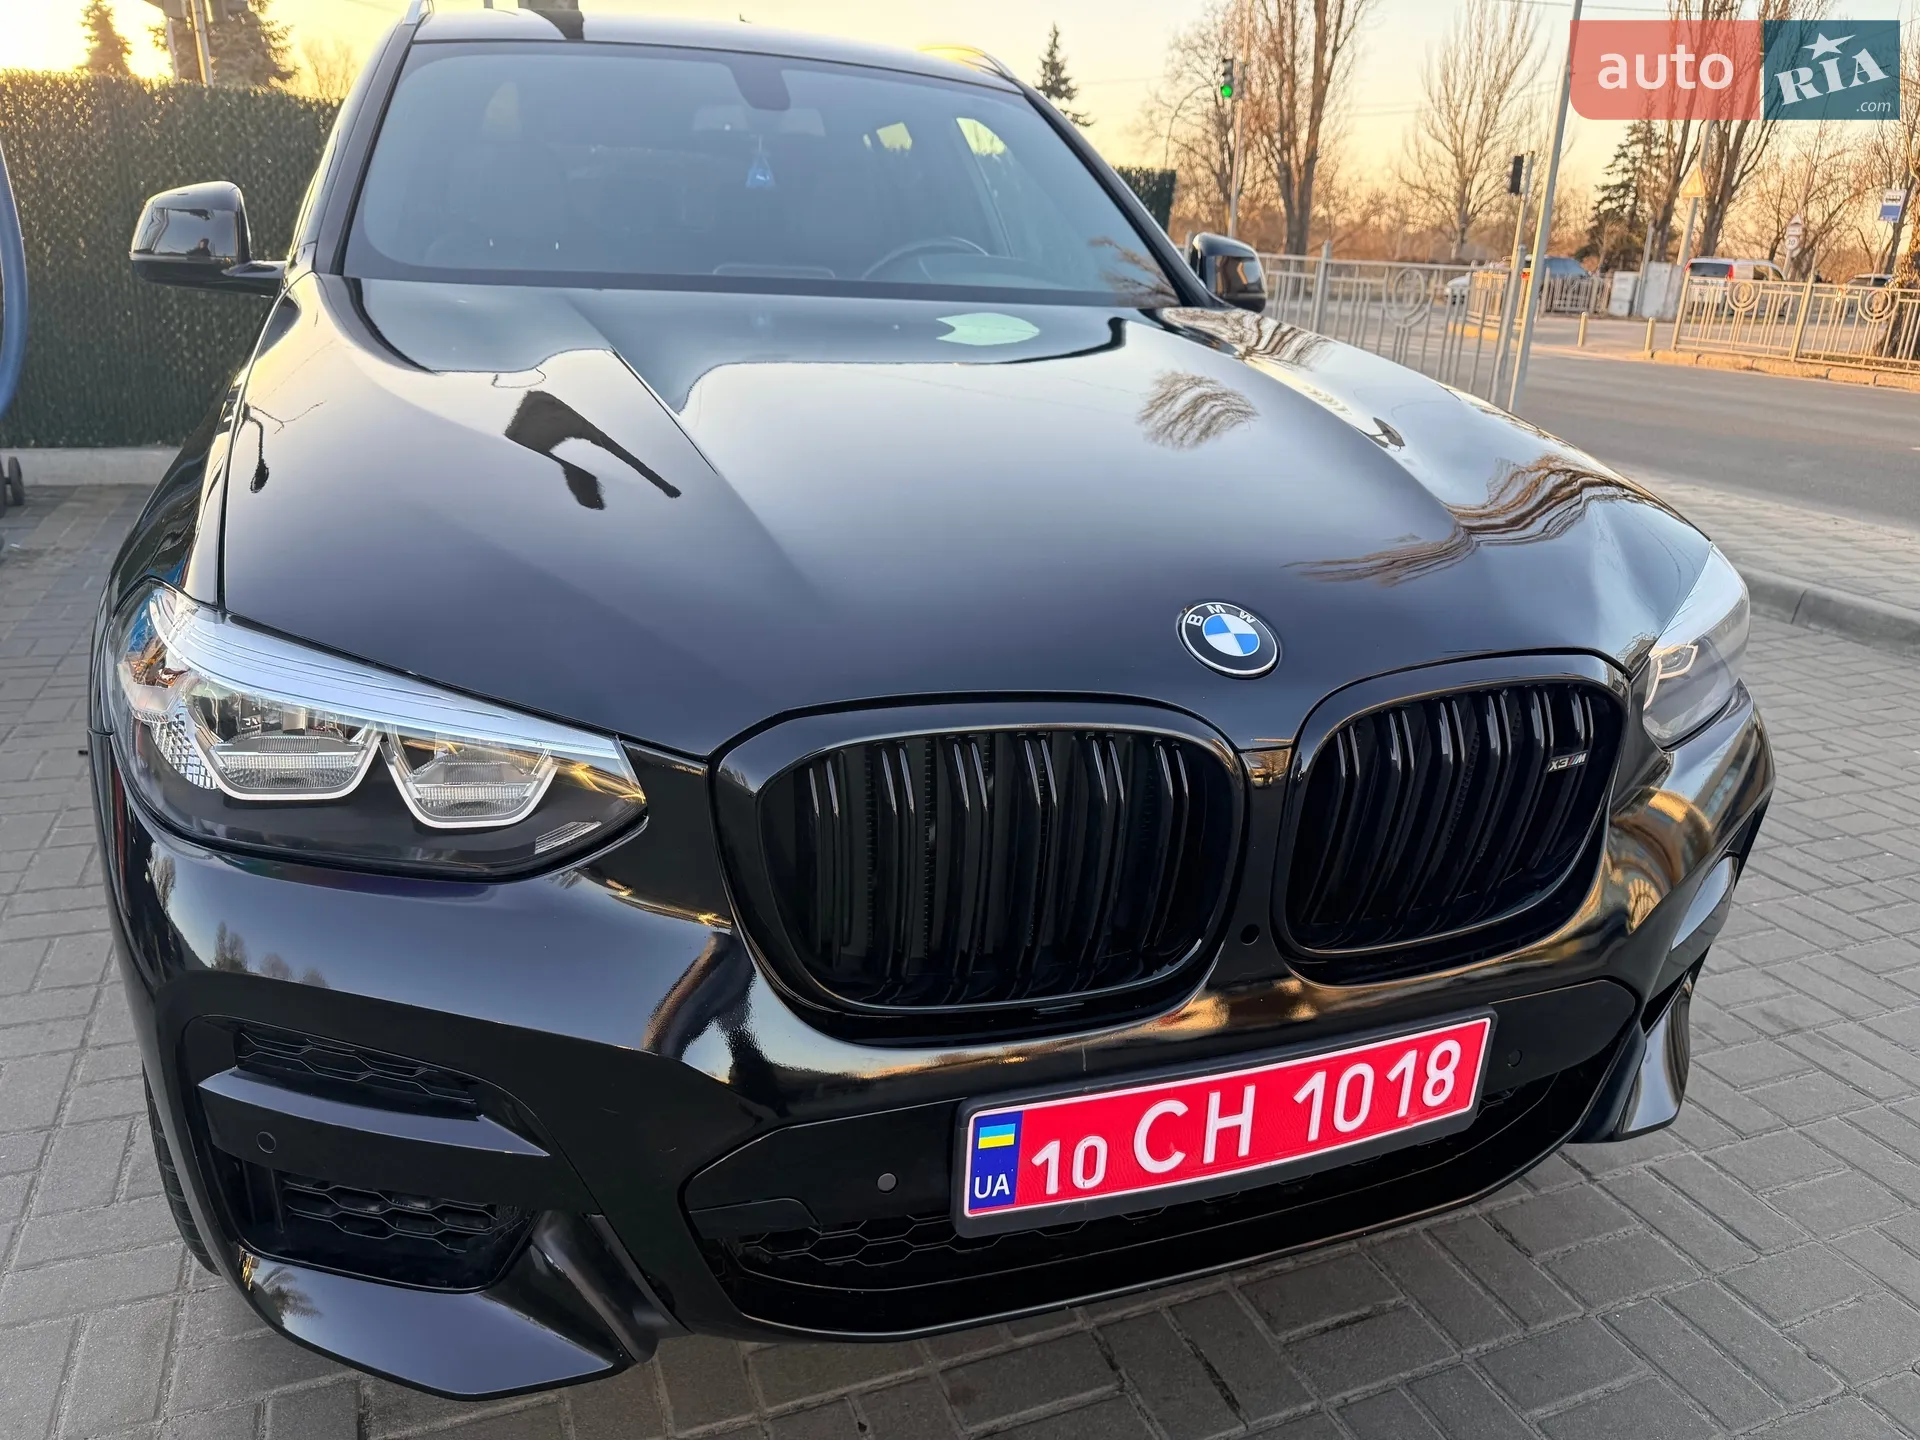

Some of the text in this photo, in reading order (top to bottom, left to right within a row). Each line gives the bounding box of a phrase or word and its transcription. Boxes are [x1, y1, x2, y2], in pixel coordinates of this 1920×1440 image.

[1187, 604, 1256, 627] BMW
[1032, 1039, 1461, 1195] 10 CH 1018
[974, 1173, 1010, 1199] UA
